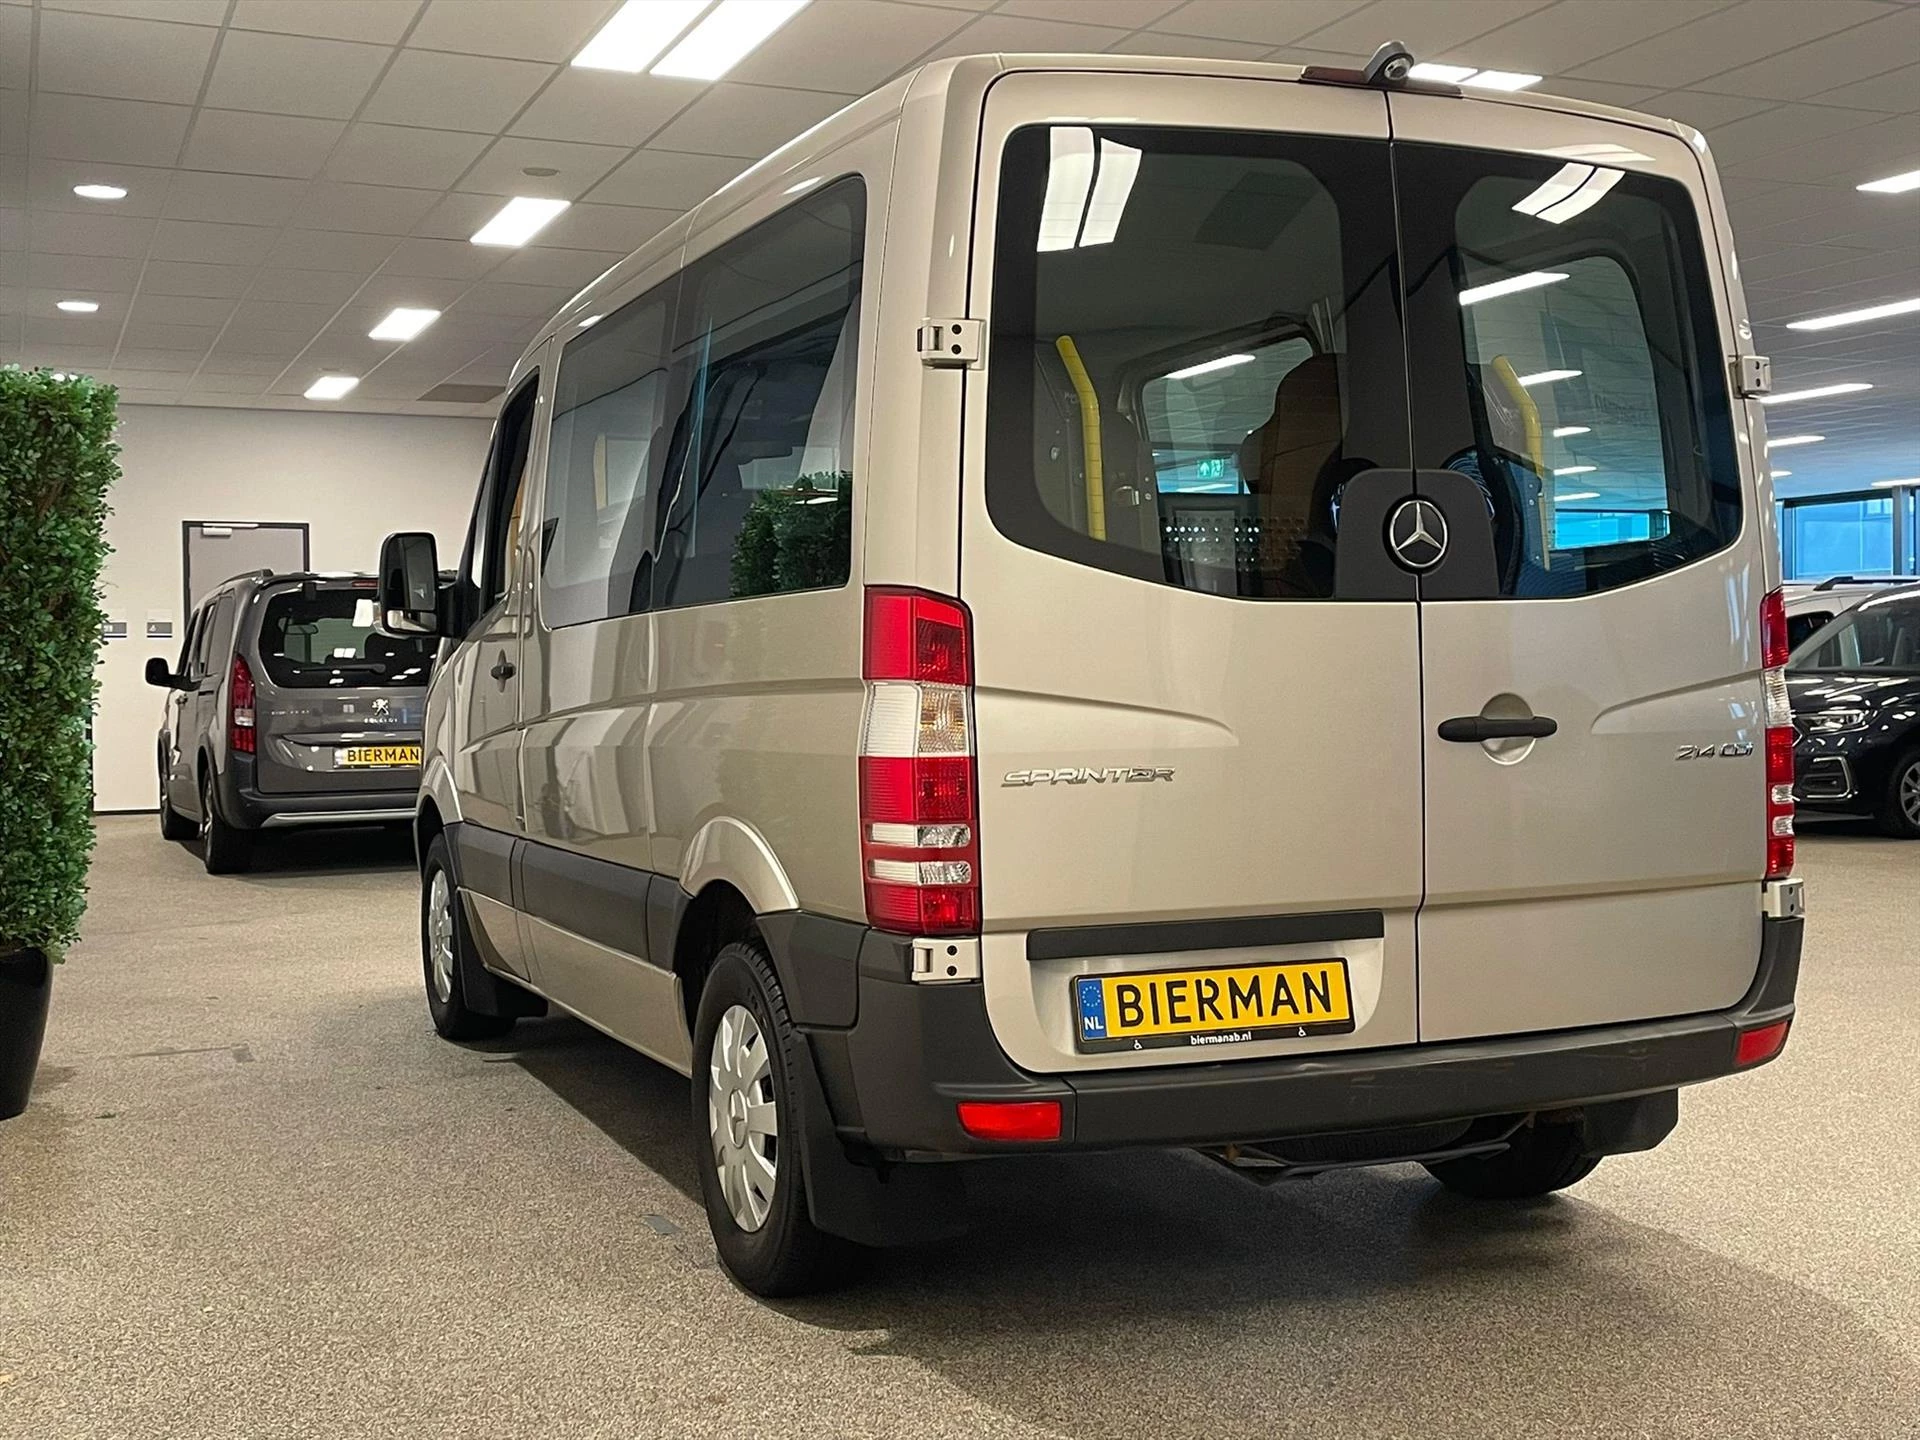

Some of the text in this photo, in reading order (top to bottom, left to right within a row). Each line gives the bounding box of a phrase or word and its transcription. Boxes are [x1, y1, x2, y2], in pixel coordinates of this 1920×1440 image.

[347, 748, 419, 762] BIERMAN
[1676, 744, 1715, 760] 214
[1002, 767, 1176, 787] SPRINTER
[1117, 970, 1332, 1028] BIERMAN
[1084, 1016, 1104, 1030] NL
[1190, 1031, 1252, 1045] biermanab.nl
